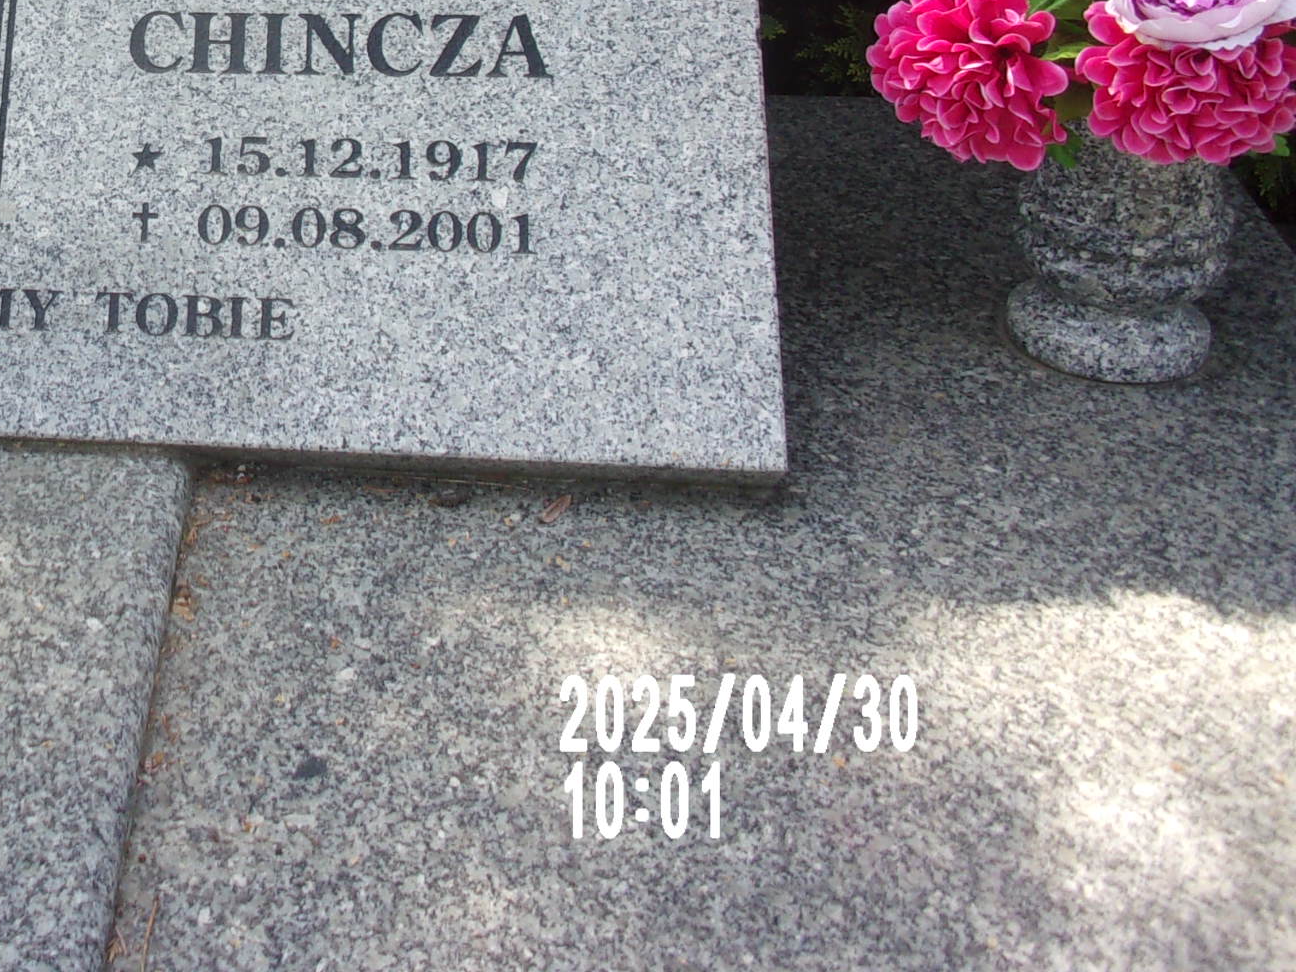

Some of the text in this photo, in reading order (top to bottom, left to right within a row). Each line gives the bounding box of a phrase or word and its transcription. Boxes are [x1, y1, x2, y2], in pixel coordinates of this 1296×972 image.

[129, 10, 553, 78] CHINCZA
[206, 136, 538, 182] 15.12.1917
[198, 204, 537, 254] 09.08.2001
[95, 291, 296, 341] TOBIE
